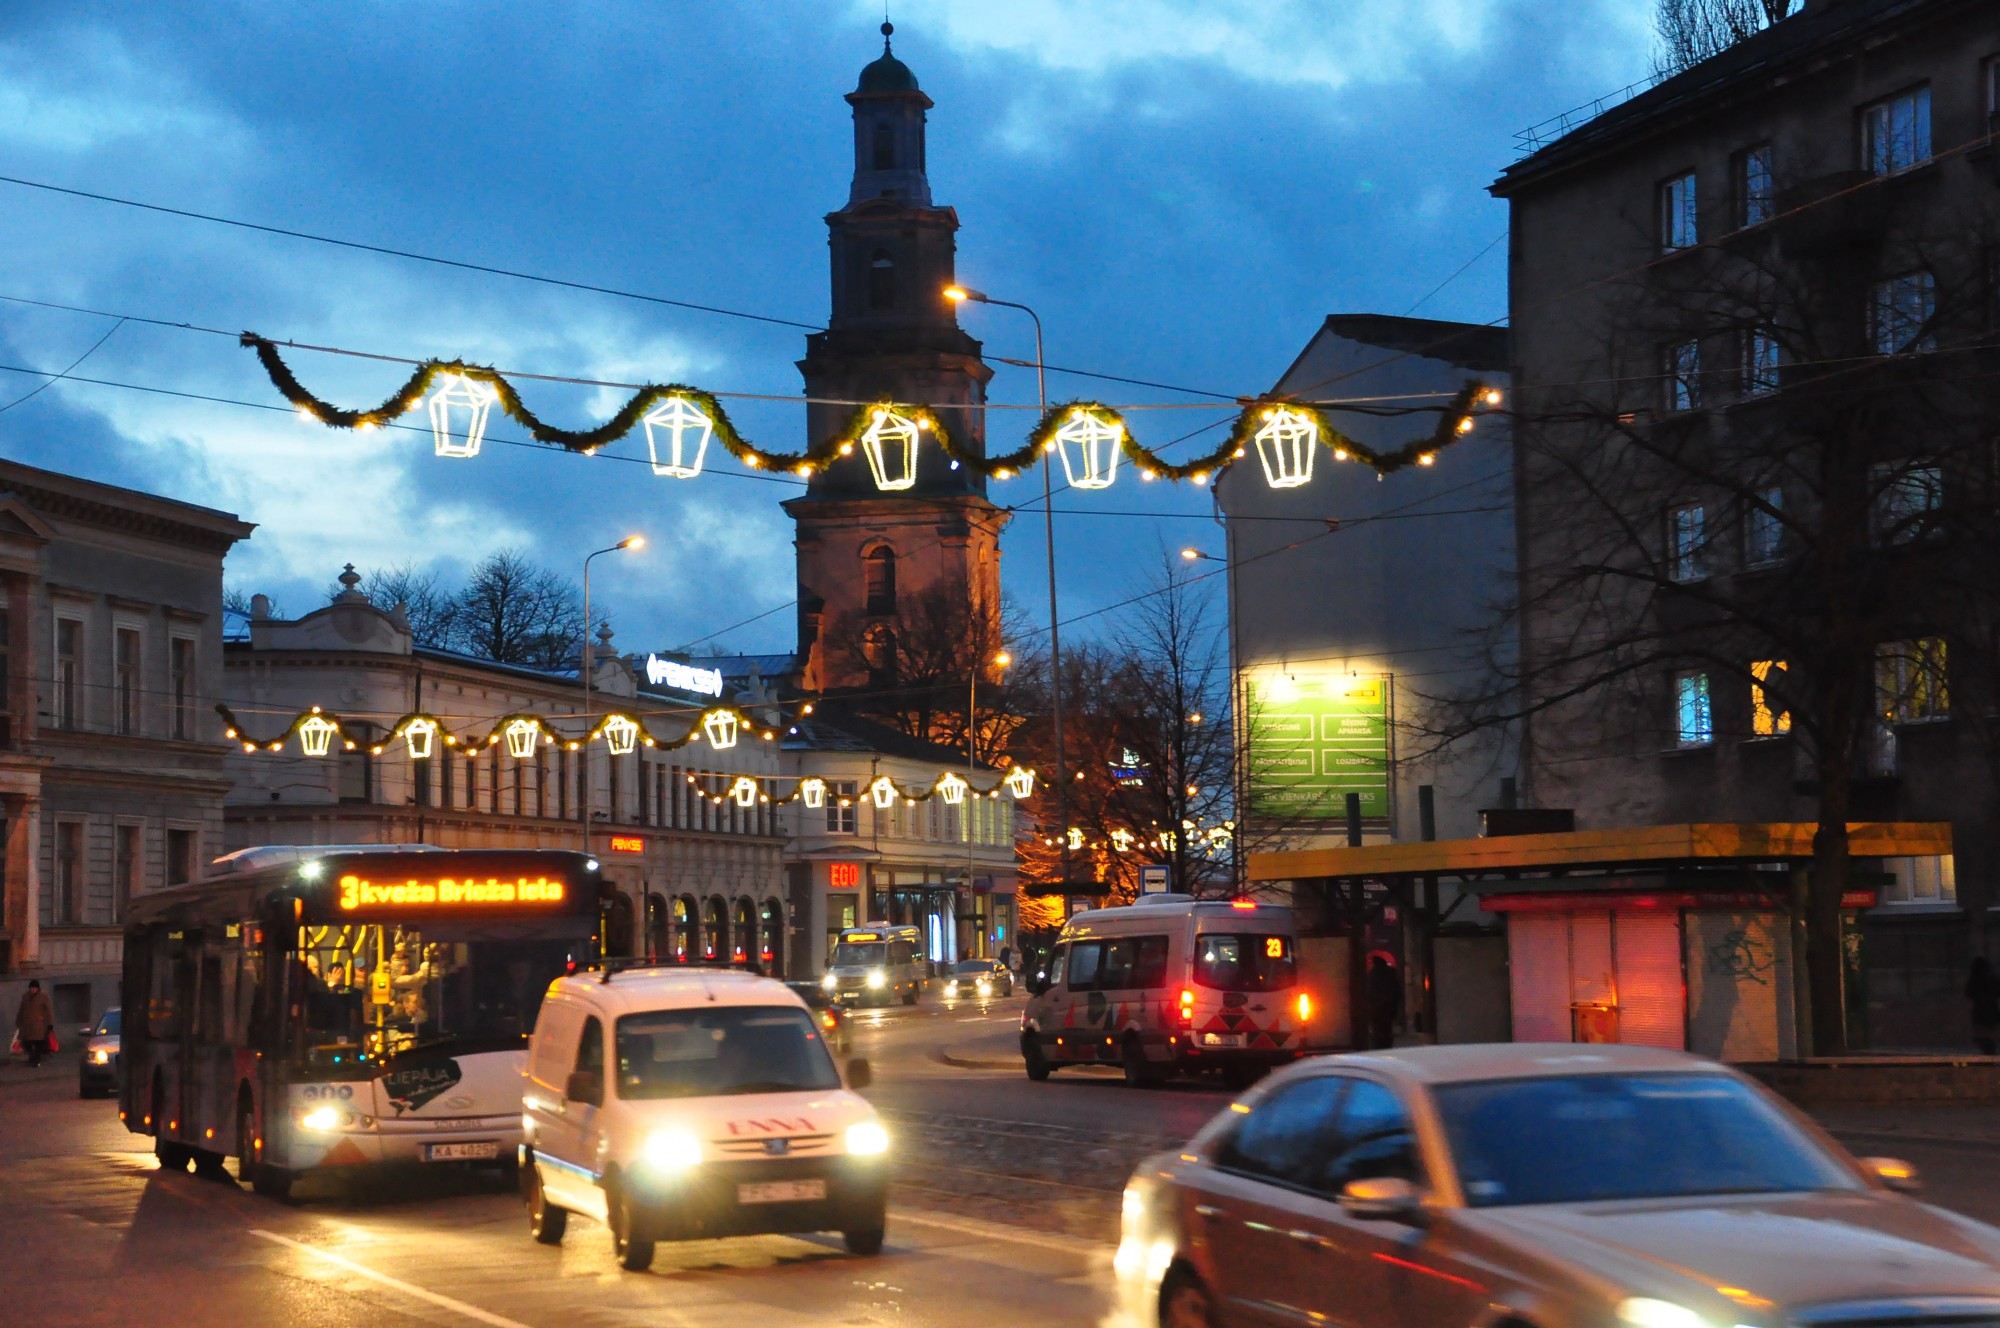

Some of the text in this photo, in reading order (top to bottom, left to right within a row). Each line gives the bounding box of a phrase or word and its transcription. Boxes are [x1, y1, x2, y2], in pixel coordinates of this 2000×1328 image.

[830, 863, 859, 887] EGO
[340, 875, 359, 909] 3
[1266, 938, 1281, 957] 23
